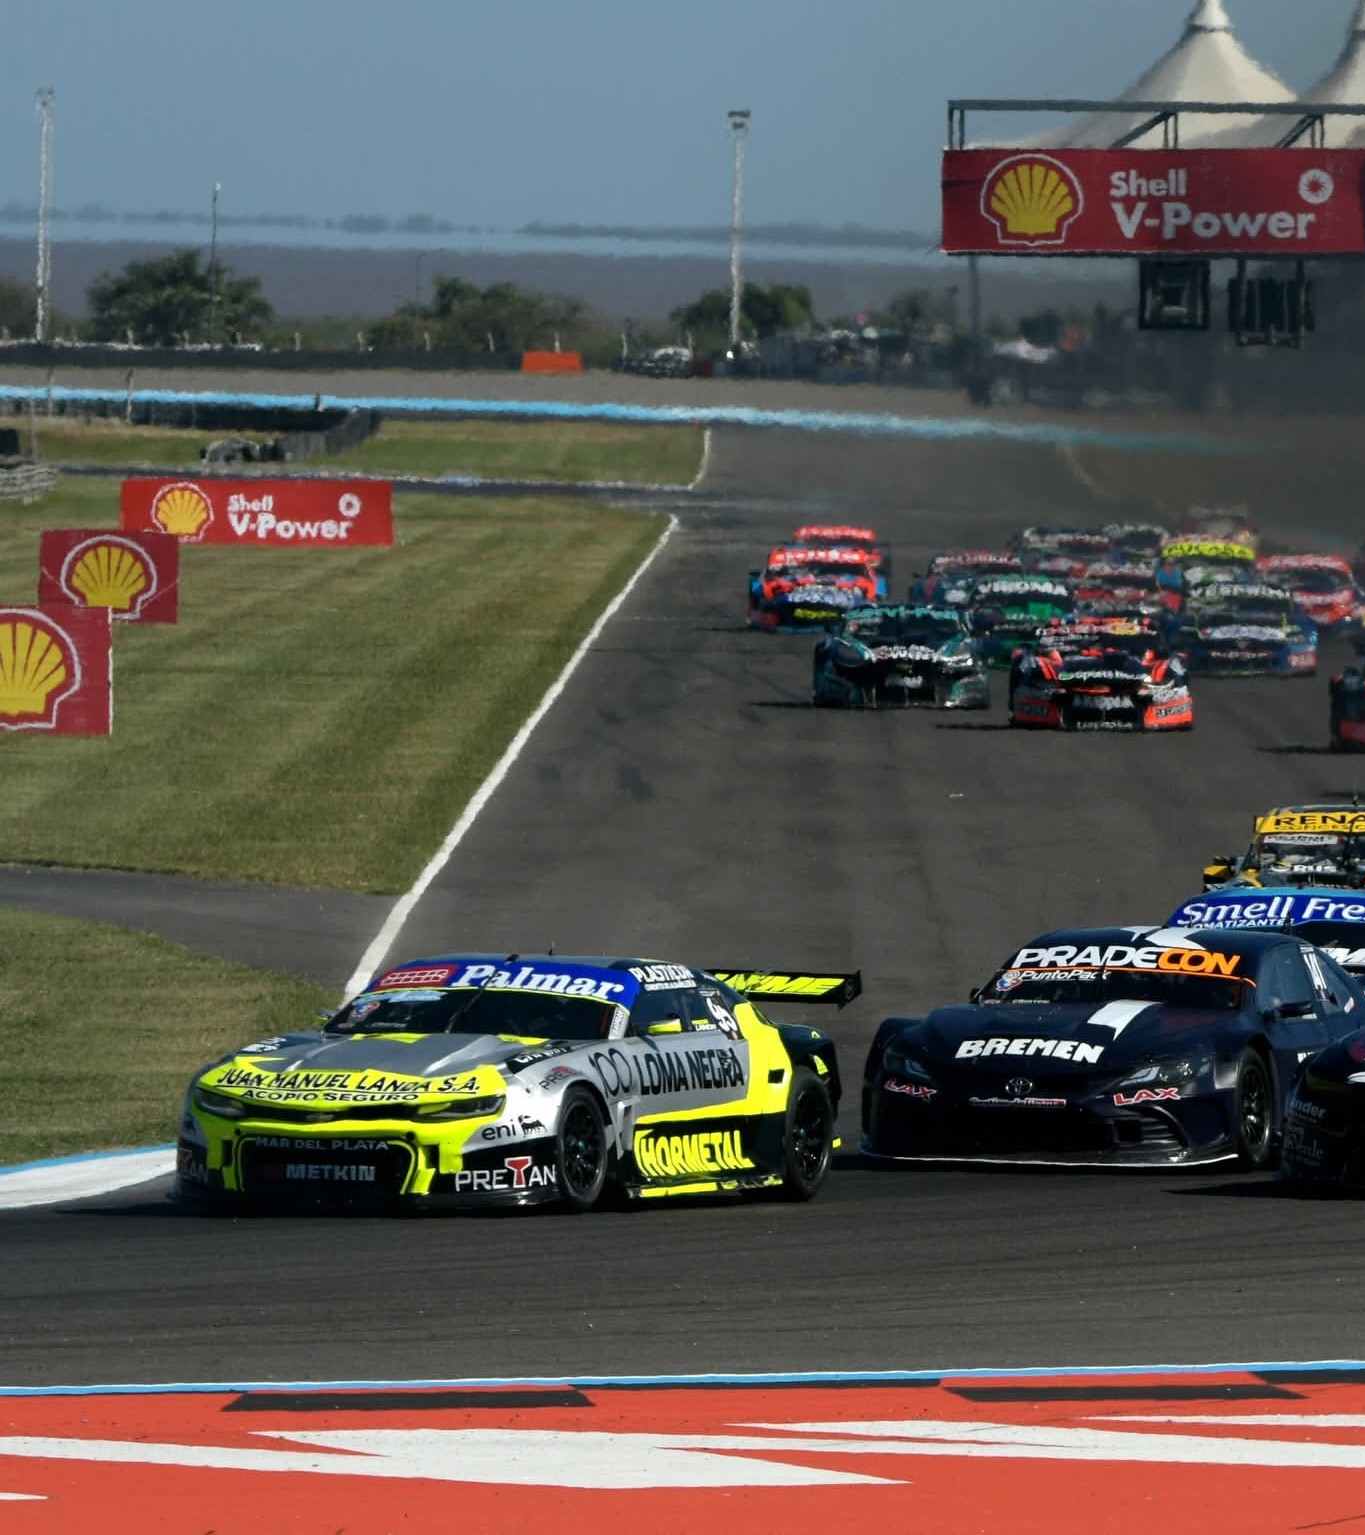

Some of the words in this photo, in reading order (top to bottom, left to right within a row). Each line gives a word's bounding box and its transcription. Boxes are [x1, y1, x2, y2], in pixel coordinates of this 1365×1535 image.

[1110, 168, 1187, 197] Shell
[1110, 201, 1317, 240] V-Power
[227, 494, 273, 513] Shell
[228, 513, 353, 539] V-Power
[1177, 897, 1296, 926] Smell
[1011, 945, 1241, 975] PRADECON
[450, 965, 625, 1000] Palmar
[954, 1038, 1105, 1065] BREMEN
[217, 1069, 270, 1087] JUAN
[271, 1072, 353, 1090] MANUEL
[634, 1051, 691, 1096] LOMA
[242, 1089, 317, 1102] ACOPIO
[325, 1091, 420, 1102] SEGURO
[1113, 1086, 1182, 1107] LAX
[482, 1117, 517, 1141] eni
[295, 1138, 326, 1150] DEL
[332, 1139, 390, 1151] PLATA
[286, 1163, 377, 1182] METKIN
